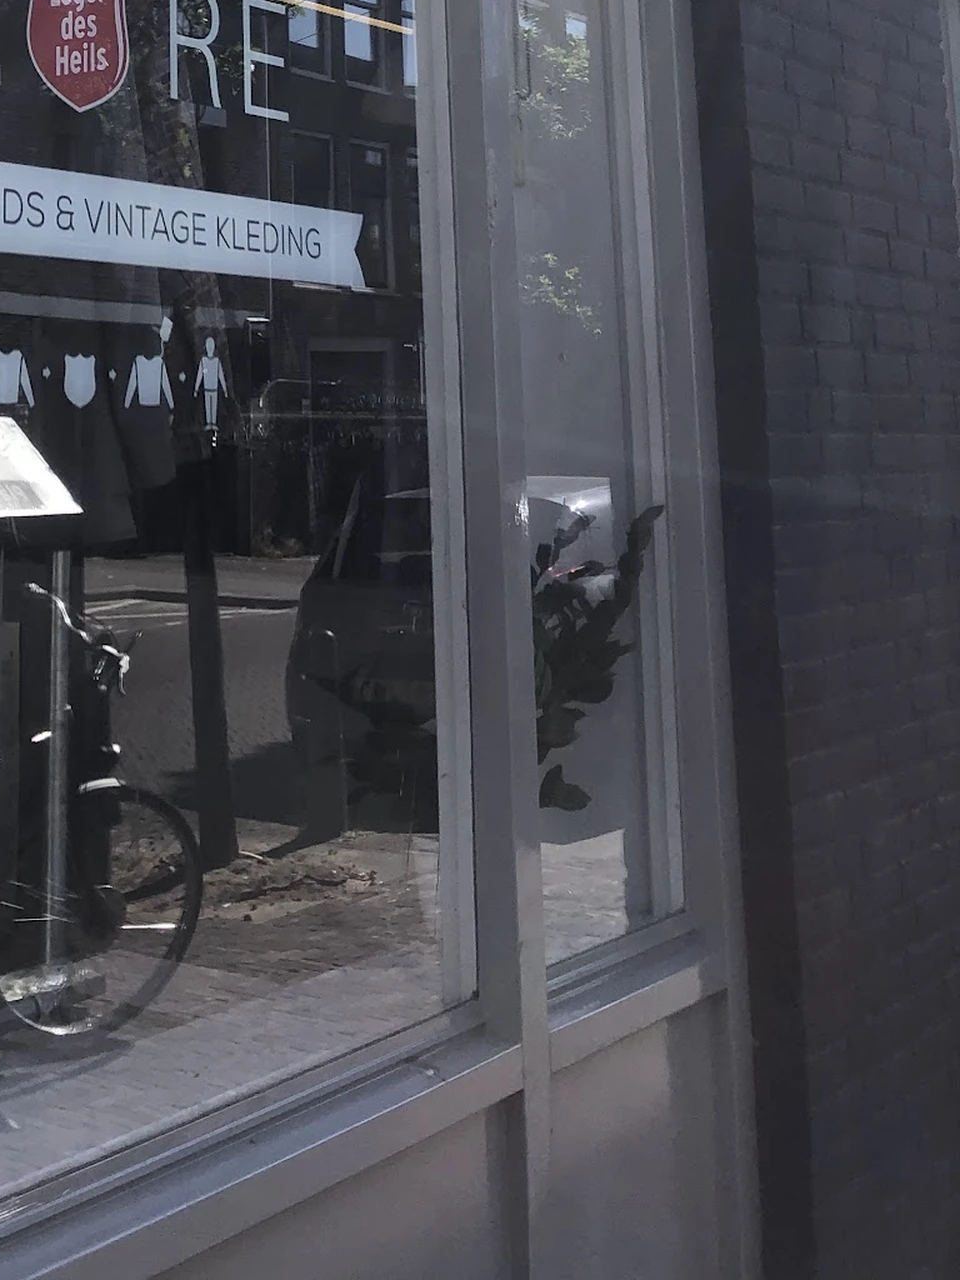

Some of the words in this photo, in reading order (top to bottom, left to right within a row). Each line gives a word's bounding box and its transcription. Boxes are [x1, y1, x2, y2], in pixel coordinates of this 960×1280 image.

[60, 10, 98, 40] des
[55, 42, 110, 77] Heils
[56, 195, 75, 231] &
[84, 198, 207, 246] VINTAGE
[216, 216, 322, 260] KLEDING
